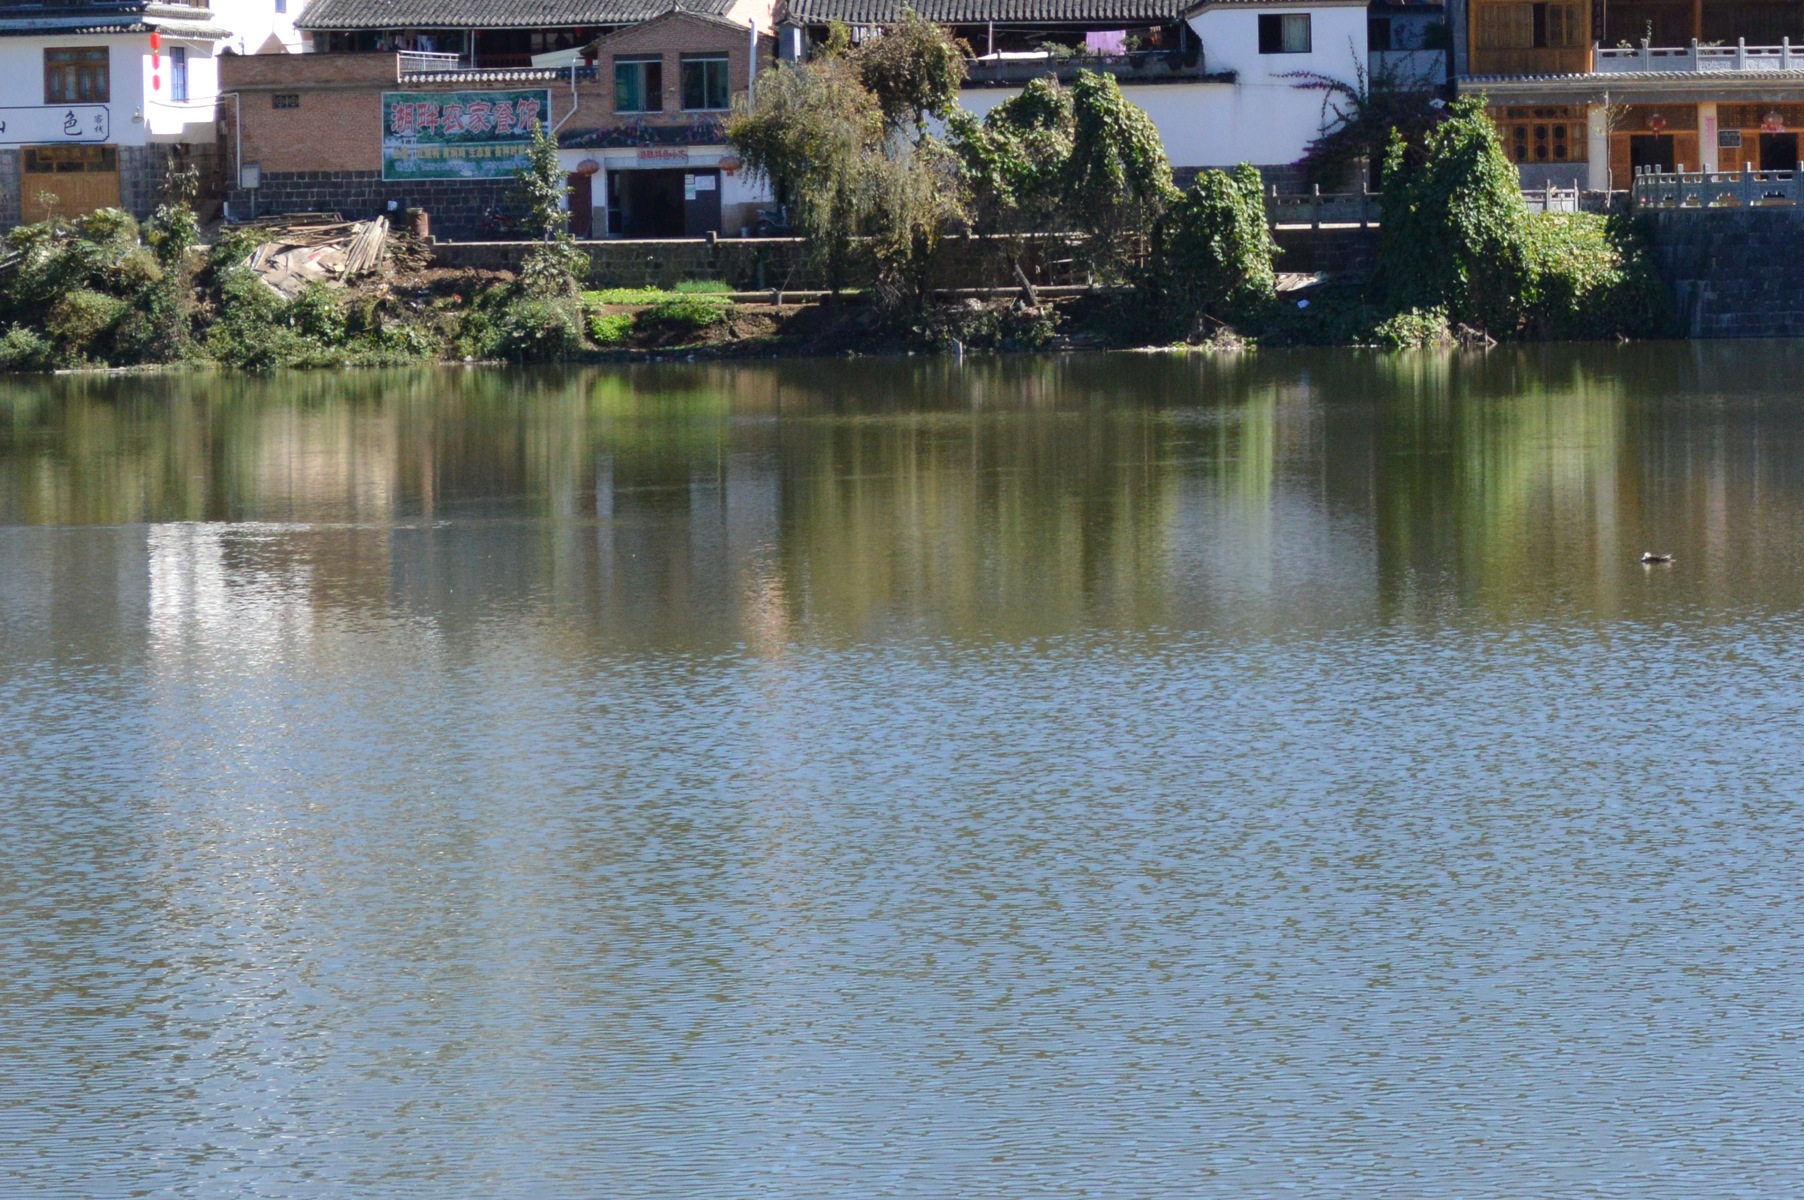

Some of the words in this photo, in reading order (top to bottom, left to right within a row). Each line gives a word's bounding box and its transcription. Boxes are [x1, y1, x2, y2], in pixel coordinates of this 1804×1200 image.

[64, 110, 82, 136] 色
[390, 98, 540, 135] 湖畔农家餐馆
